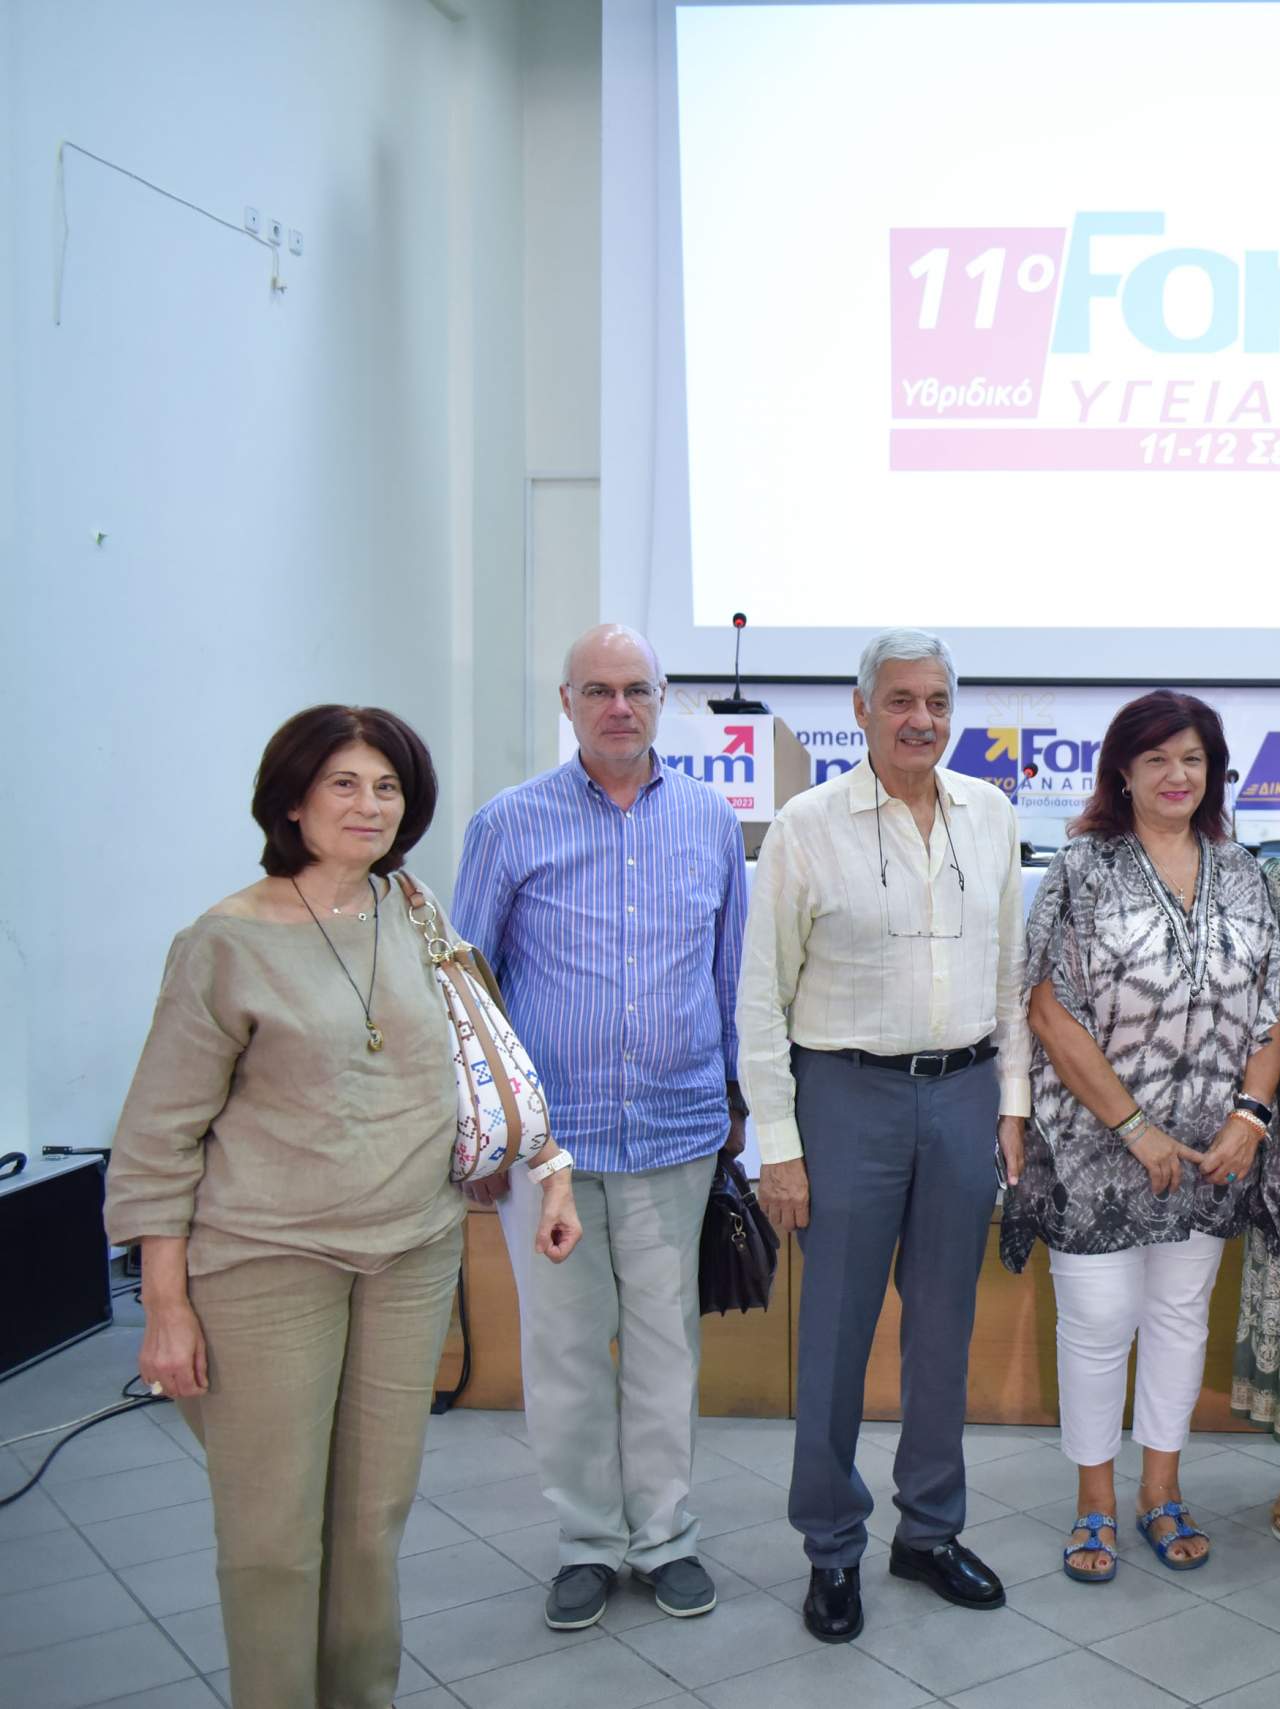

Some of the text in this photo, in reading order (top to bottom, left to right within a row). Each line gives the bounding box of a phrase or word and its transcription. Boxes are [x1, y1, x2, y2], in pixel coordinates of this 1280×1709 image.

[901, 377, 1034, 413] Υβριδικό
[1138, 433, 1236, 466] 11-12
[1021, 728, 1101, 773] For
